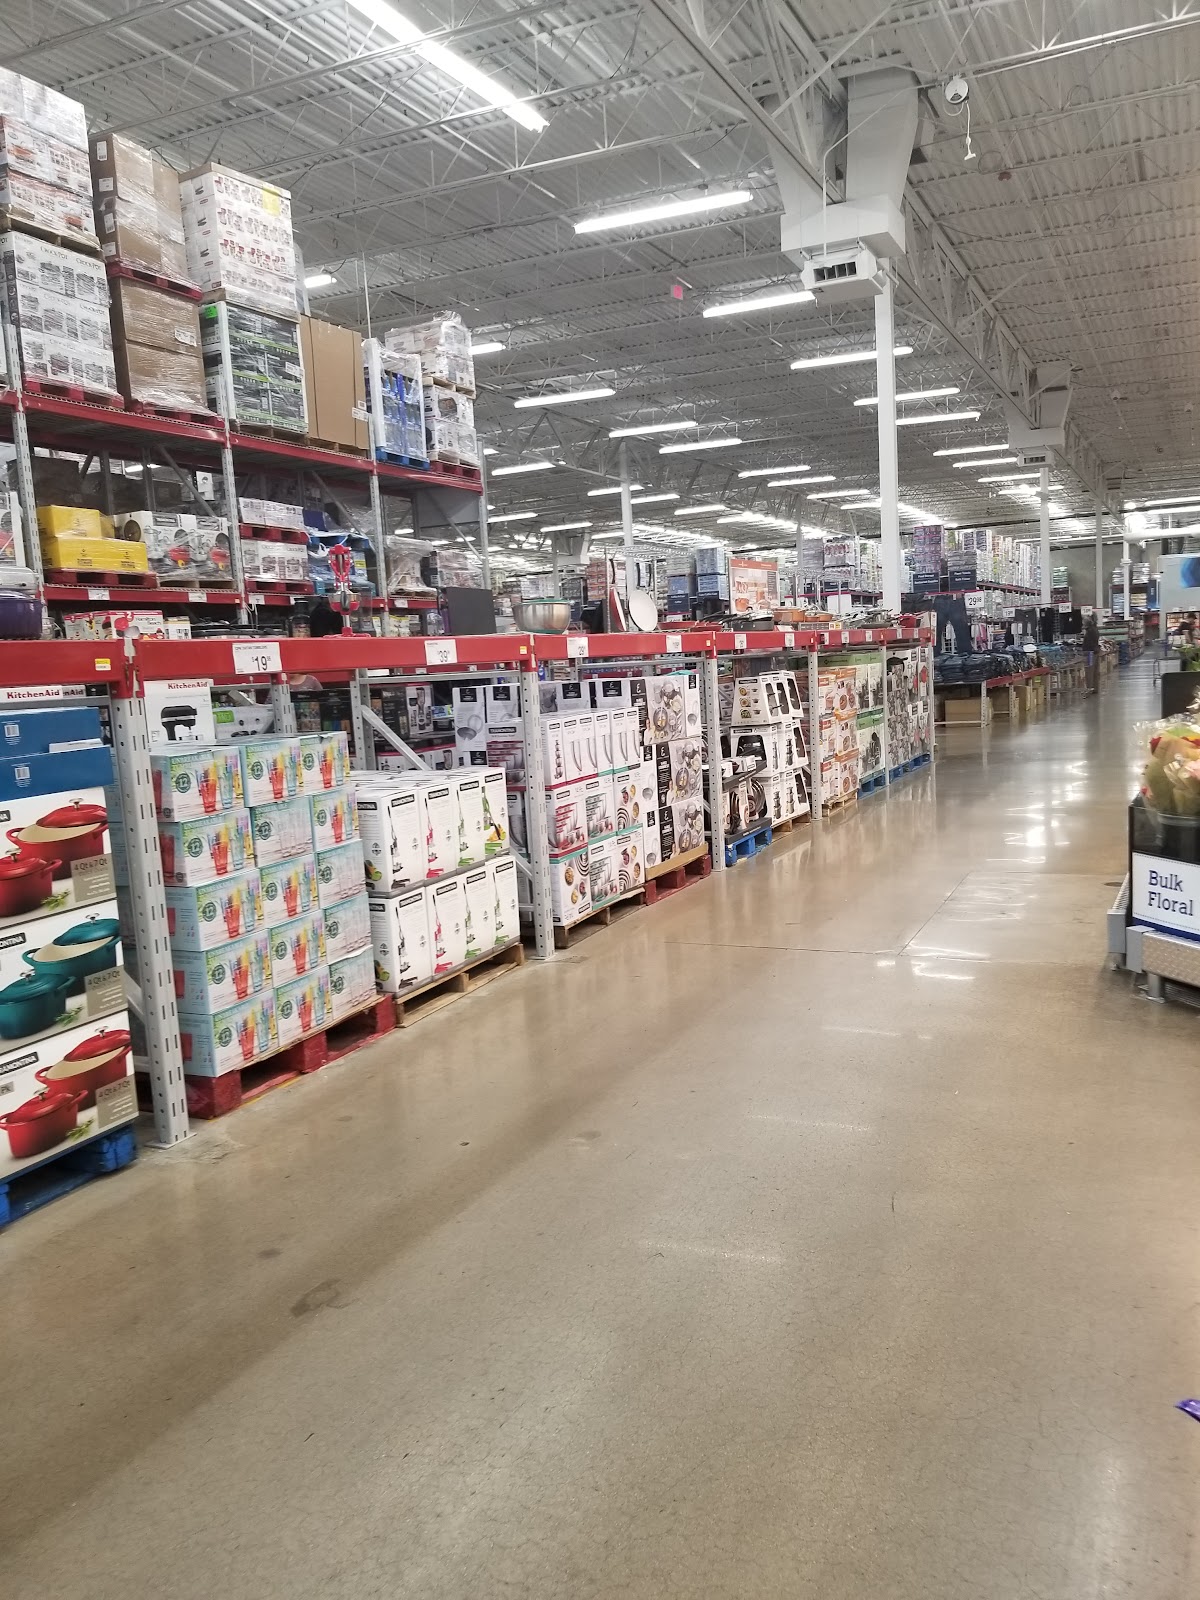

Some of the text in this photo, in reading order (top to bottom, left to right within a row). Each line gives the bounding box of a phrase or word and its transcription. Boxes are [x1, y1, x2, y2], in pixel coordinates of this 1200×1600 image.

[7, 690, 60, 699] KitchenAid
[1148, 870, 1183, 892] Bulk
[1148, 891, 1193, 916] Floral
[0, 936, 24, 947] ONTINA
